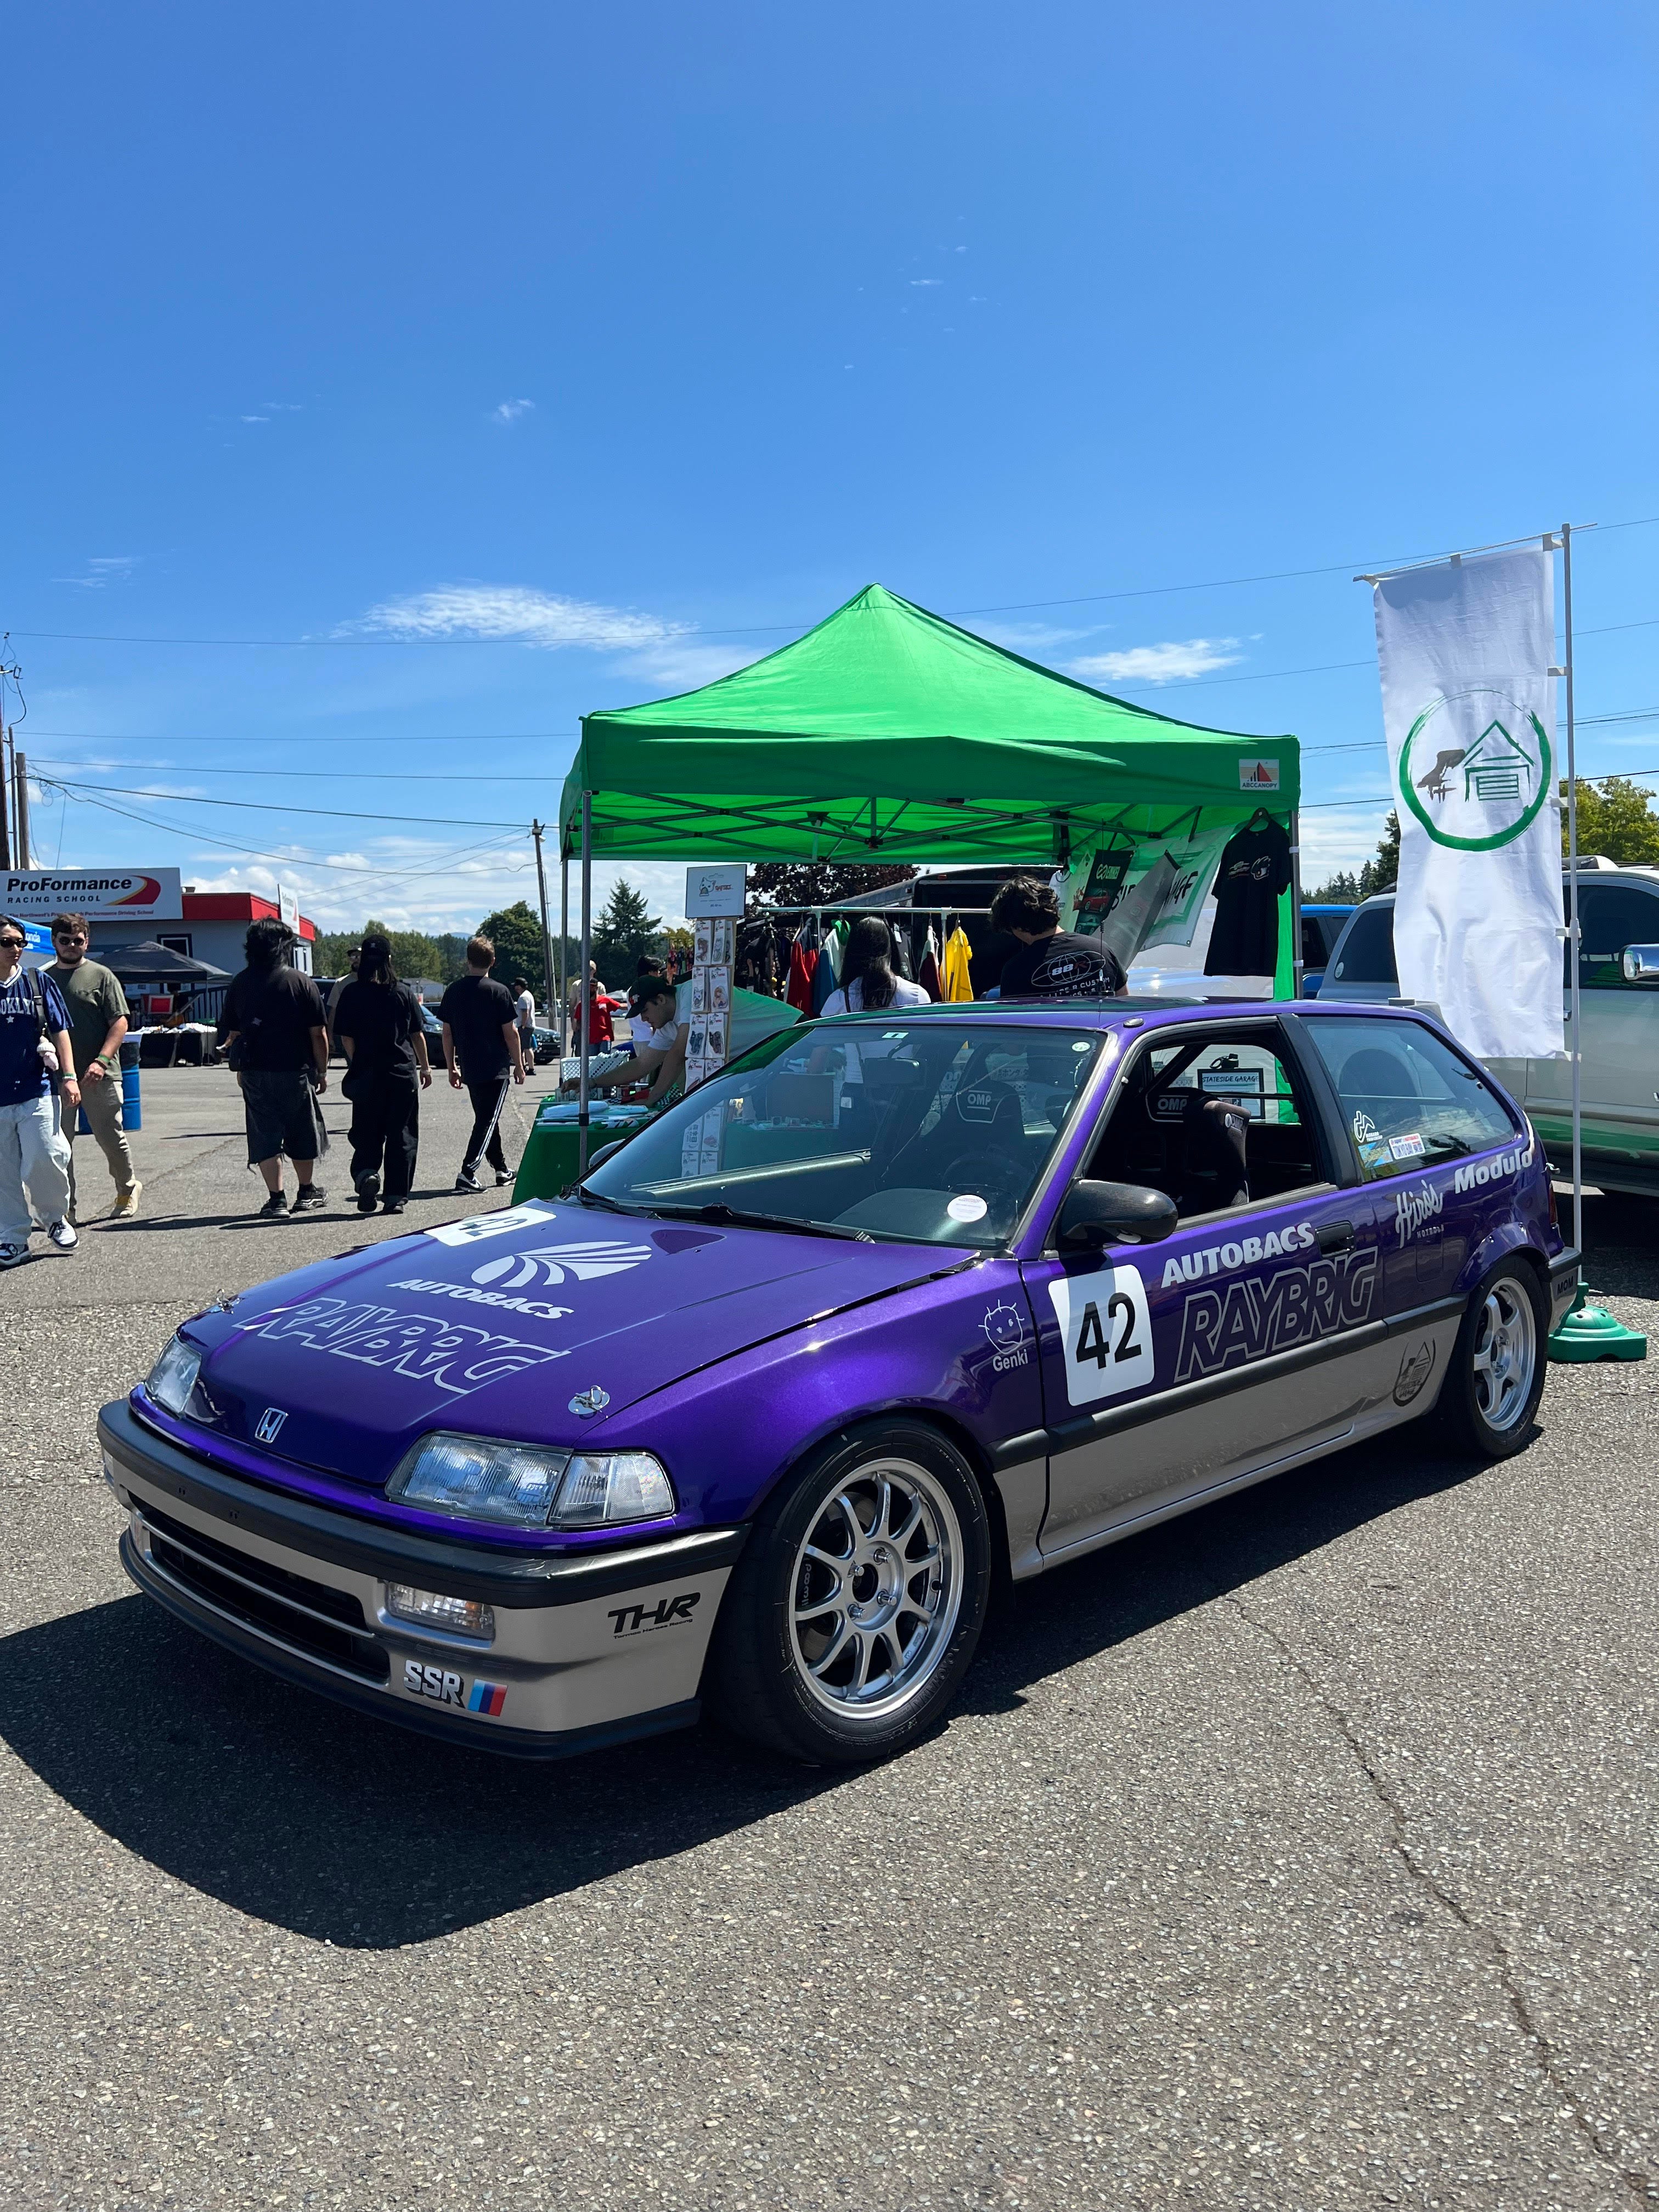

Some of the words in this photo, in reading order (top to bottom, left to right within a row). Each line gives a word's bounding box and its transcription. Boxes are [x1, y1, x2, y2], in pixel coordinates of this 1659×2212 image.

[7, 877, 132, 891] ProFormance
[967, 1093, 991, 1105] OMP
[1158, 1098, 1187, 1110] OMP
[1455, 1148, 1533, 1194] Modulo
[459, 1216, 528, 1237] 42
[1395, 1180, 1443, 1249] Hiro's
[1161, 1222, 1315, 1288] AUTOBACS
[386, 1279, 575, 1319] AUTOBACS
[1173, 1245, 1379, 1383] RAYBRIG
[232, 1297, 572, 1394] RAYBRIG
[1076, 1292, 1142, 1370] 42
[992, 1348, 1028, 1372] Genki
[607, 1592, 701, 1633] THR
[642, 1625, 668, 1633] Heroes
[669, 1618, 693, 1627] Racing
[403, 1659, 466, 1709] SSR
